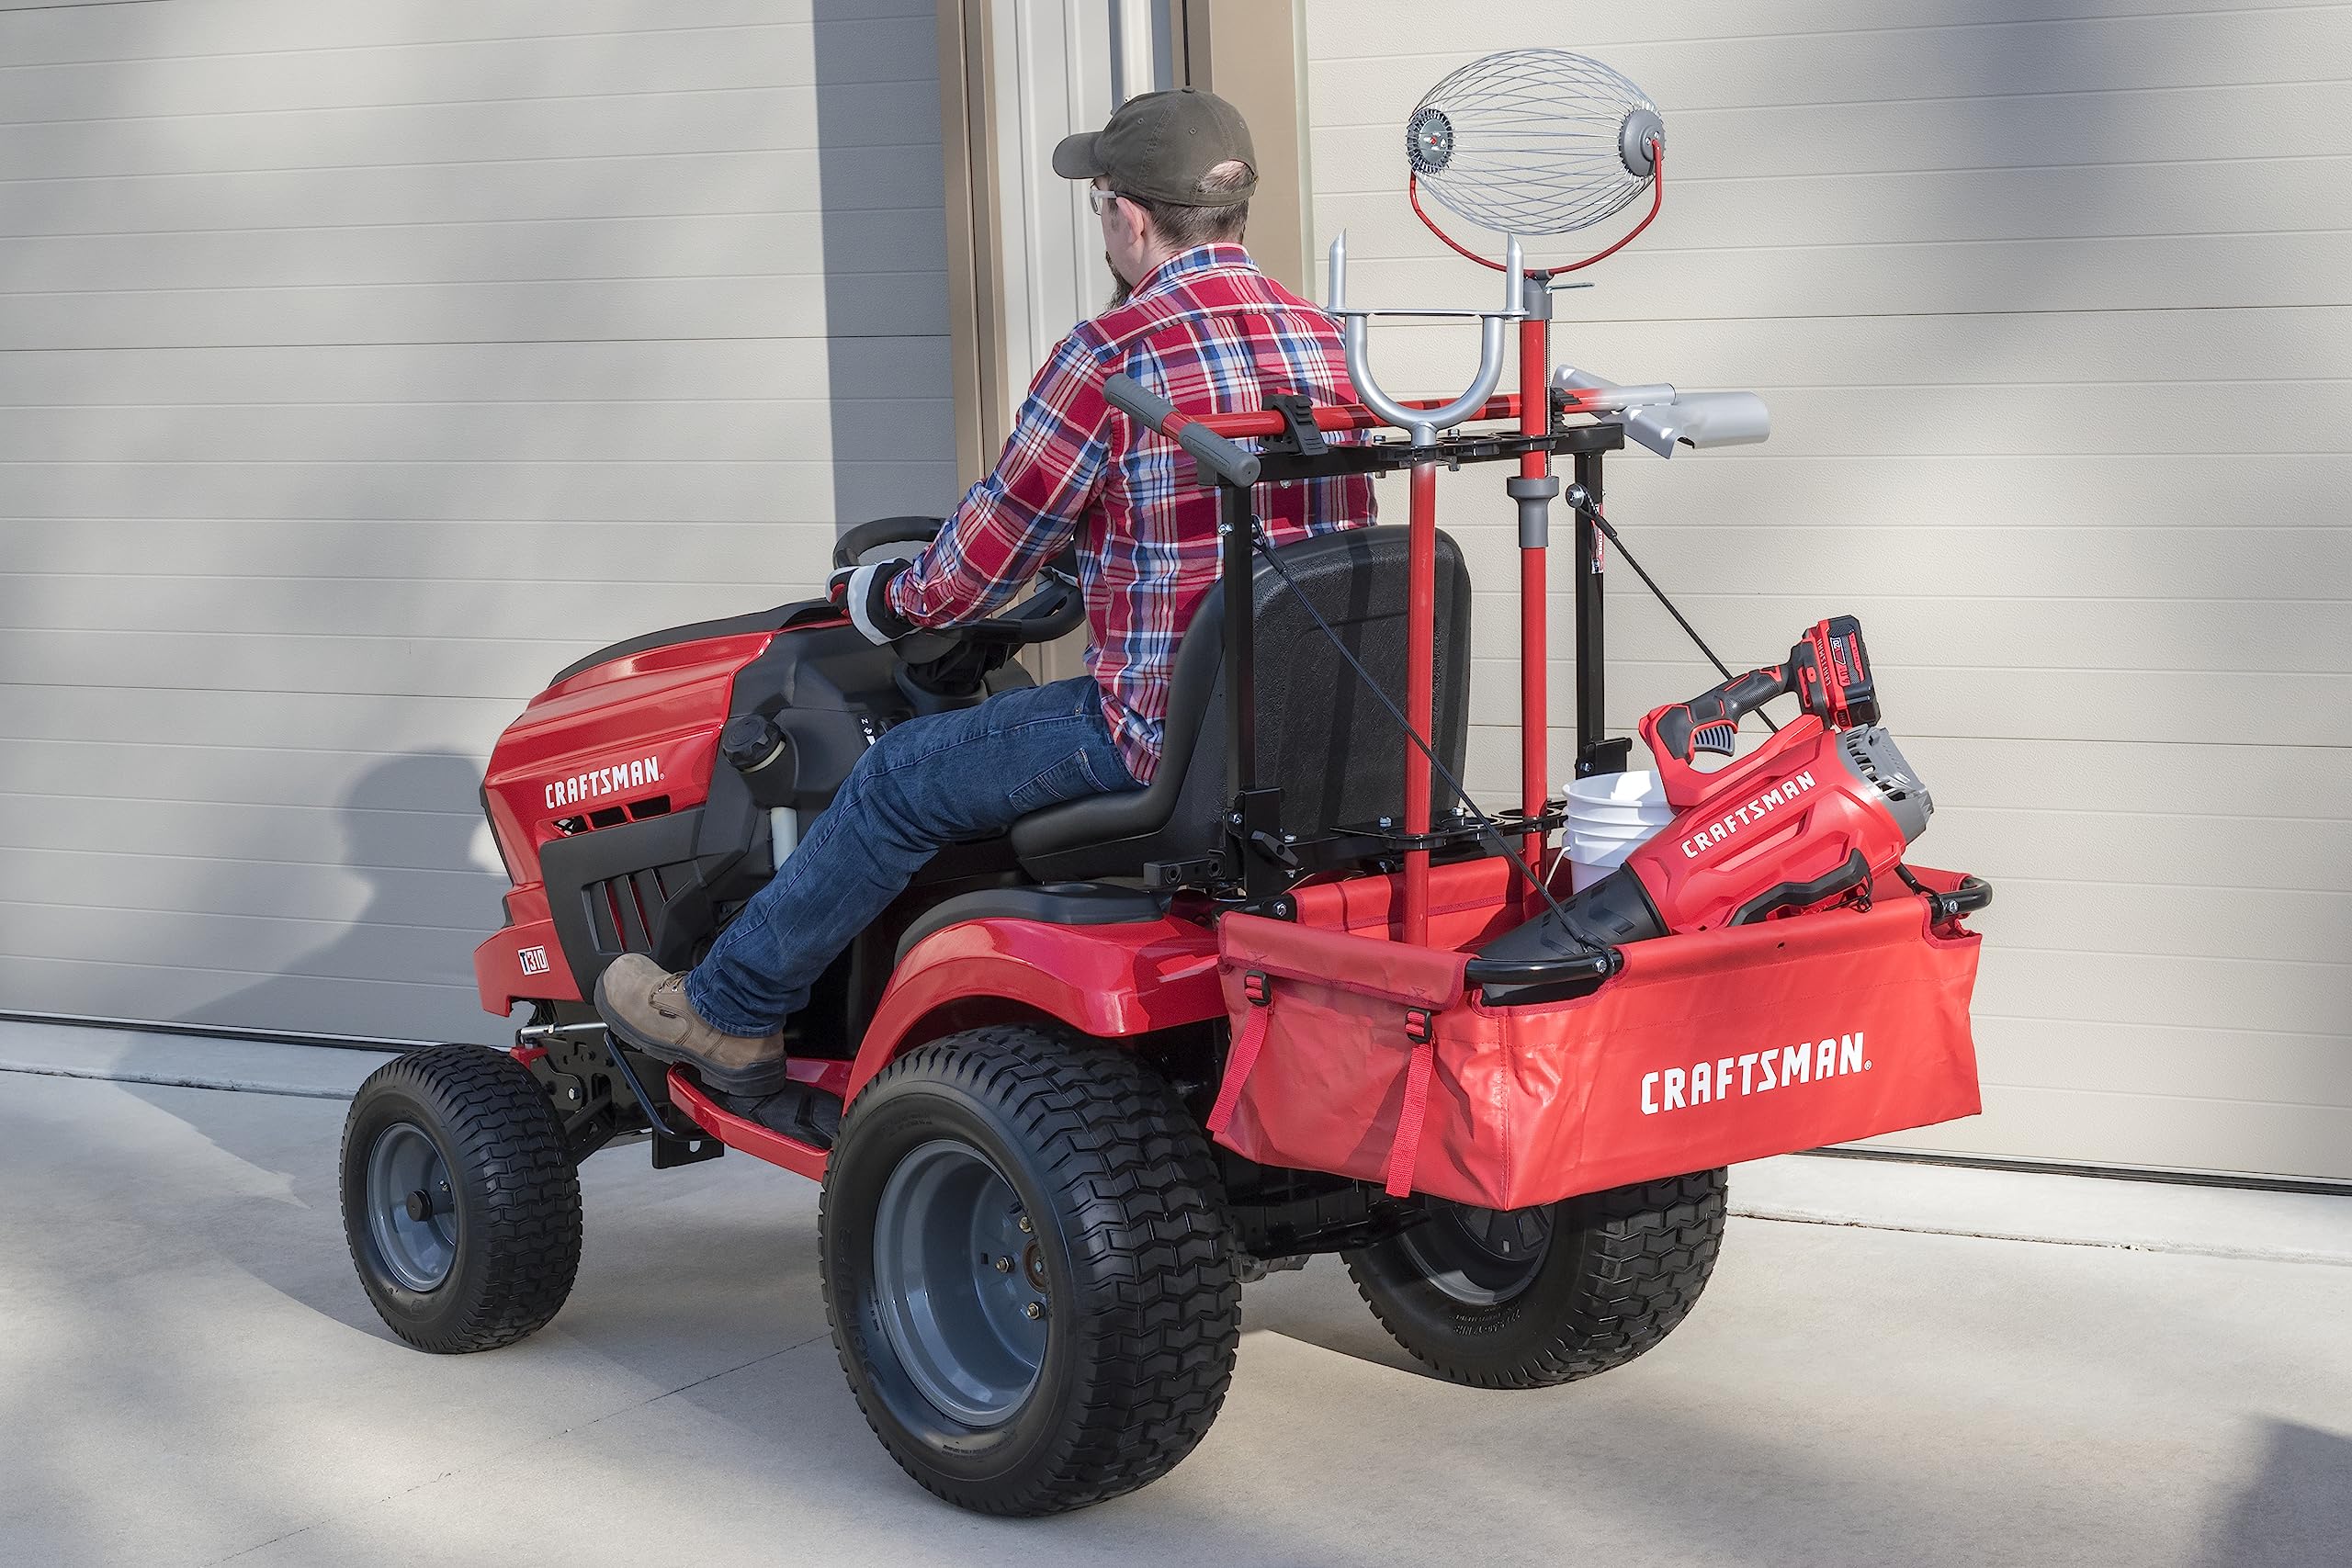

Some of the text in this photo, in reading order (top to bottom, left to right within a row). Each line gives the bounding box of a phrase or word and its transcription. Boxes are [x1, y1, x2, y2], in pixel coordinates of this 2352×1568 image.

[1816, 637, 1831, 686] CRAFTSMAN
[1680, 770, 1816, 859] CRAFTSMAN
[519, 949, 548, 973] T310
